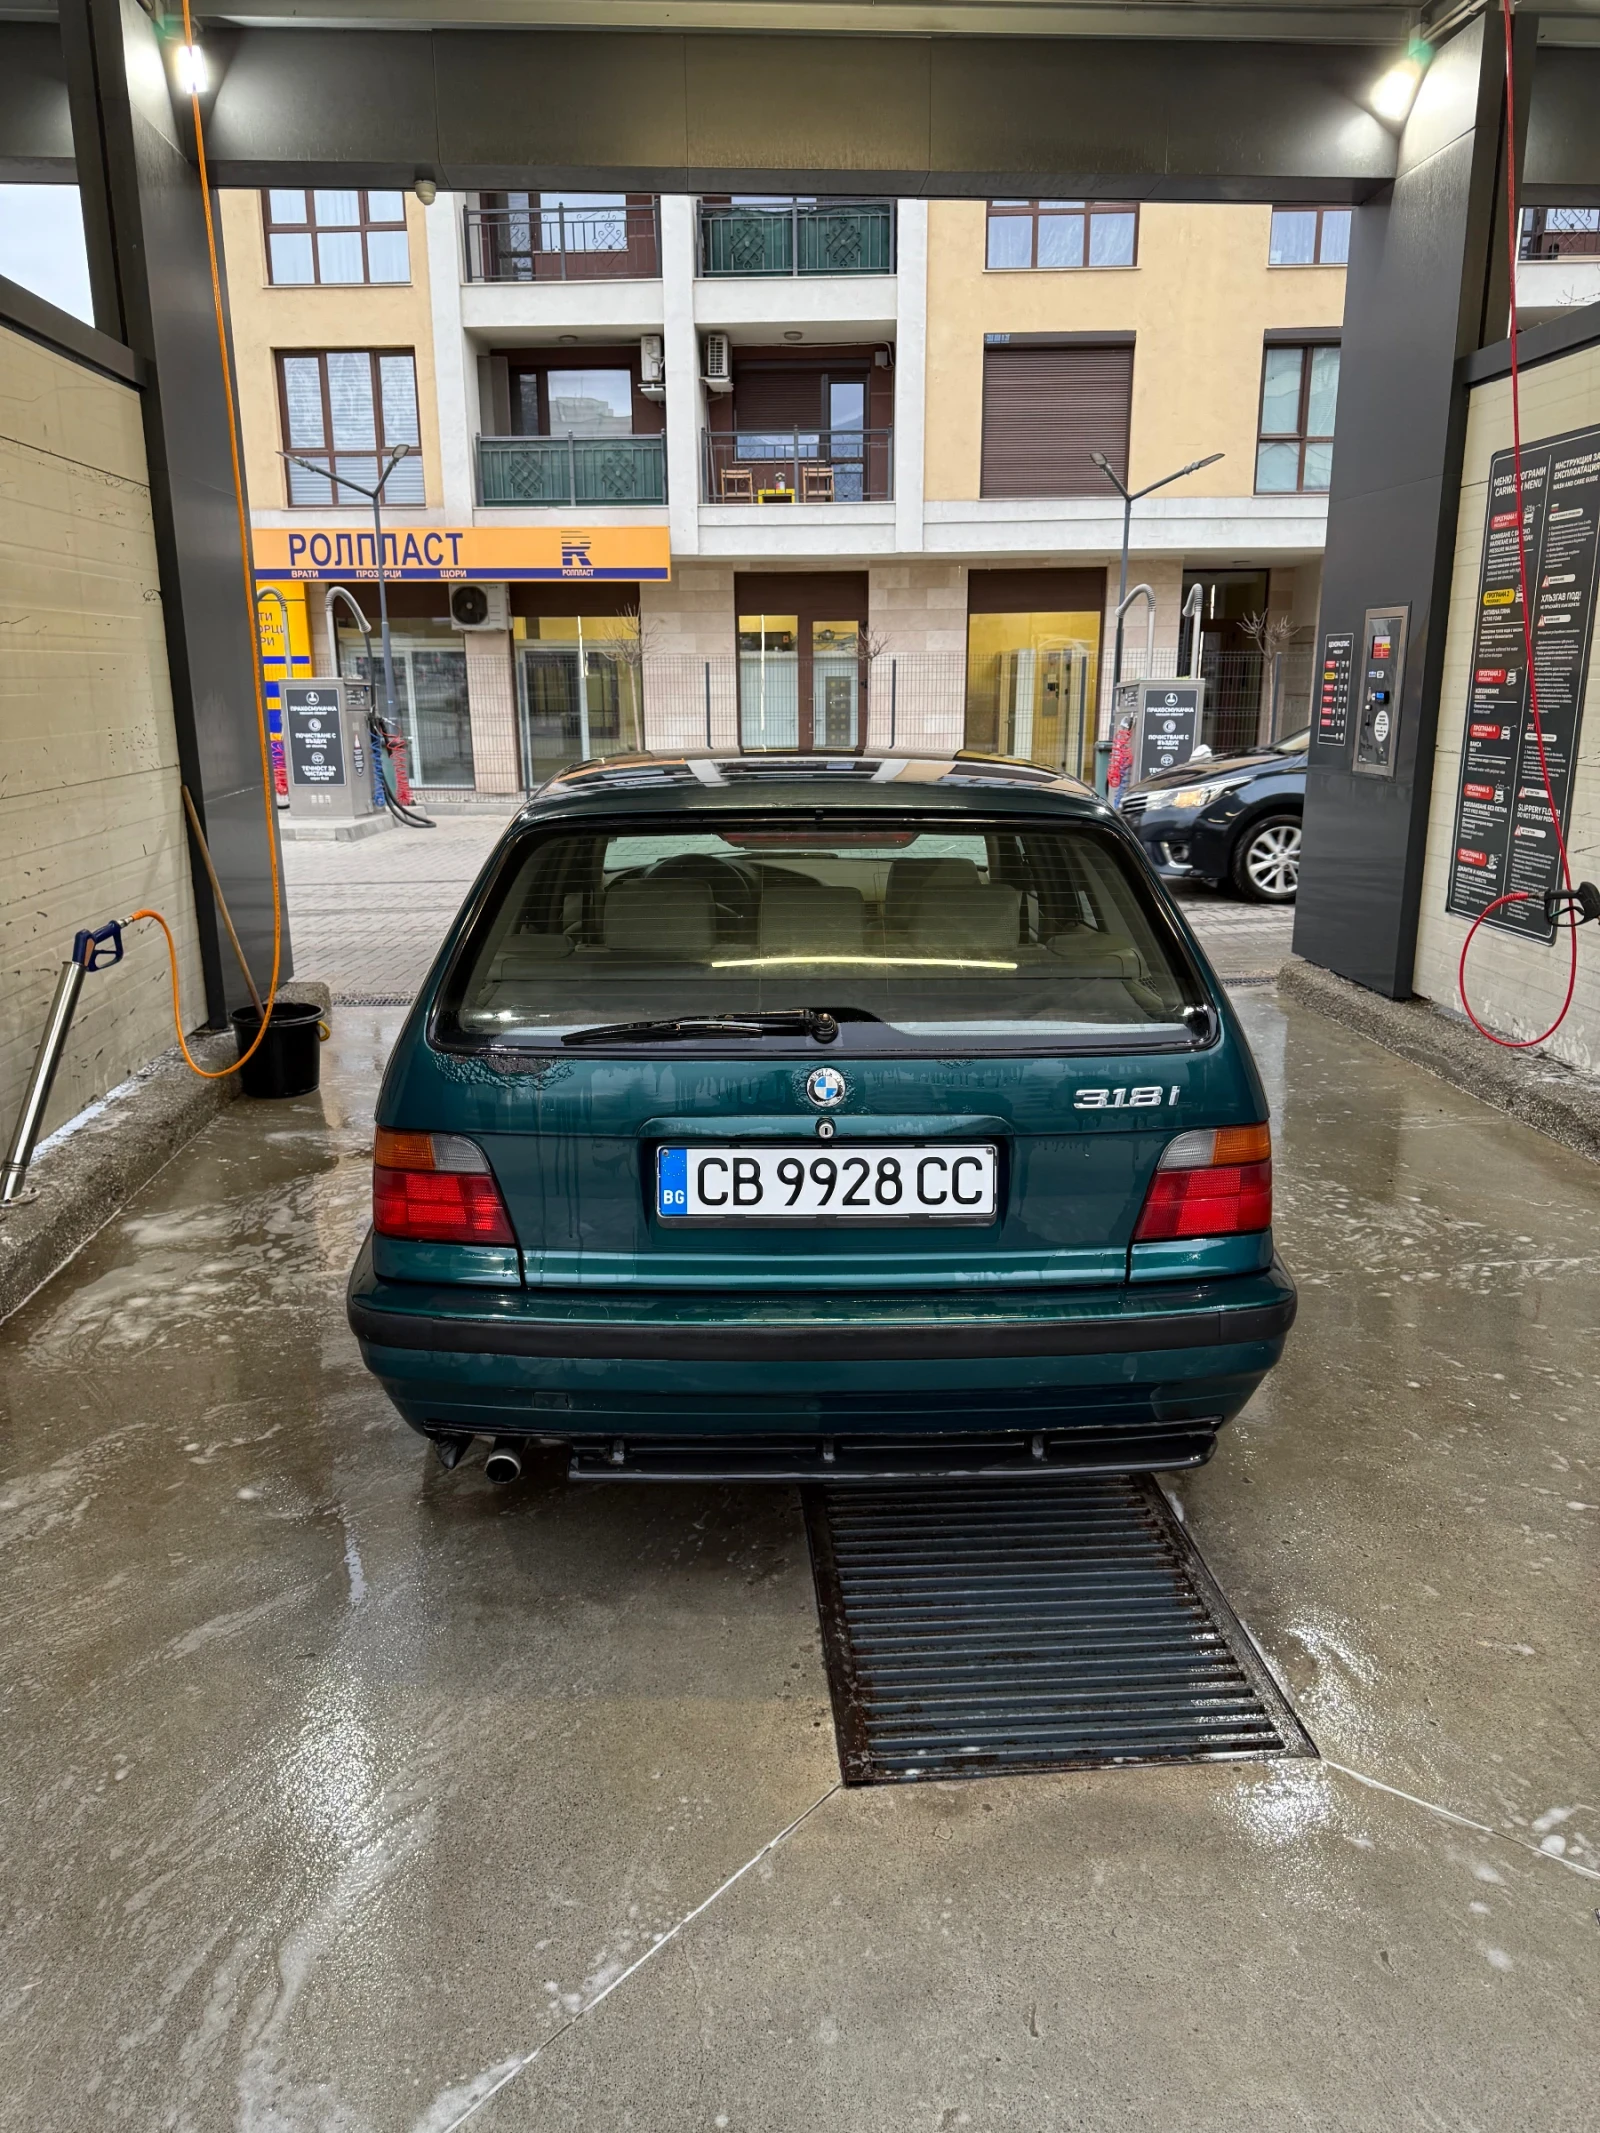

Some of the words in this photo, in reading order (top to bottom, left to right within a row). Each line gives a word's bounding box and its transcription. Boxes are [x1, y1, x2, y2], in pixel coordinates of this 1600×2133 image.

[1494, 474, 1512, 487] МЕНЮ
[1524, 478, 1542, 490] MENU
[288, 532, 463, 566] РОЛПЛАСТ
[291, 570, 319, 578] ВРАТИ
[356, 570, 402, 578] ПРОЗРЦИ
[440, 570, 467, 578] ЩОРИ
[1518, 804, 1541, 814] SLIPPERY
[1073, 1086, 1181, 1109] 318i
[697, 1157, 764, 1206] CB
[776, 1157, 902, 1206] 9928
[917, 1156, 982, 1205] CC
[663, 1190, 685, 1204] BG
